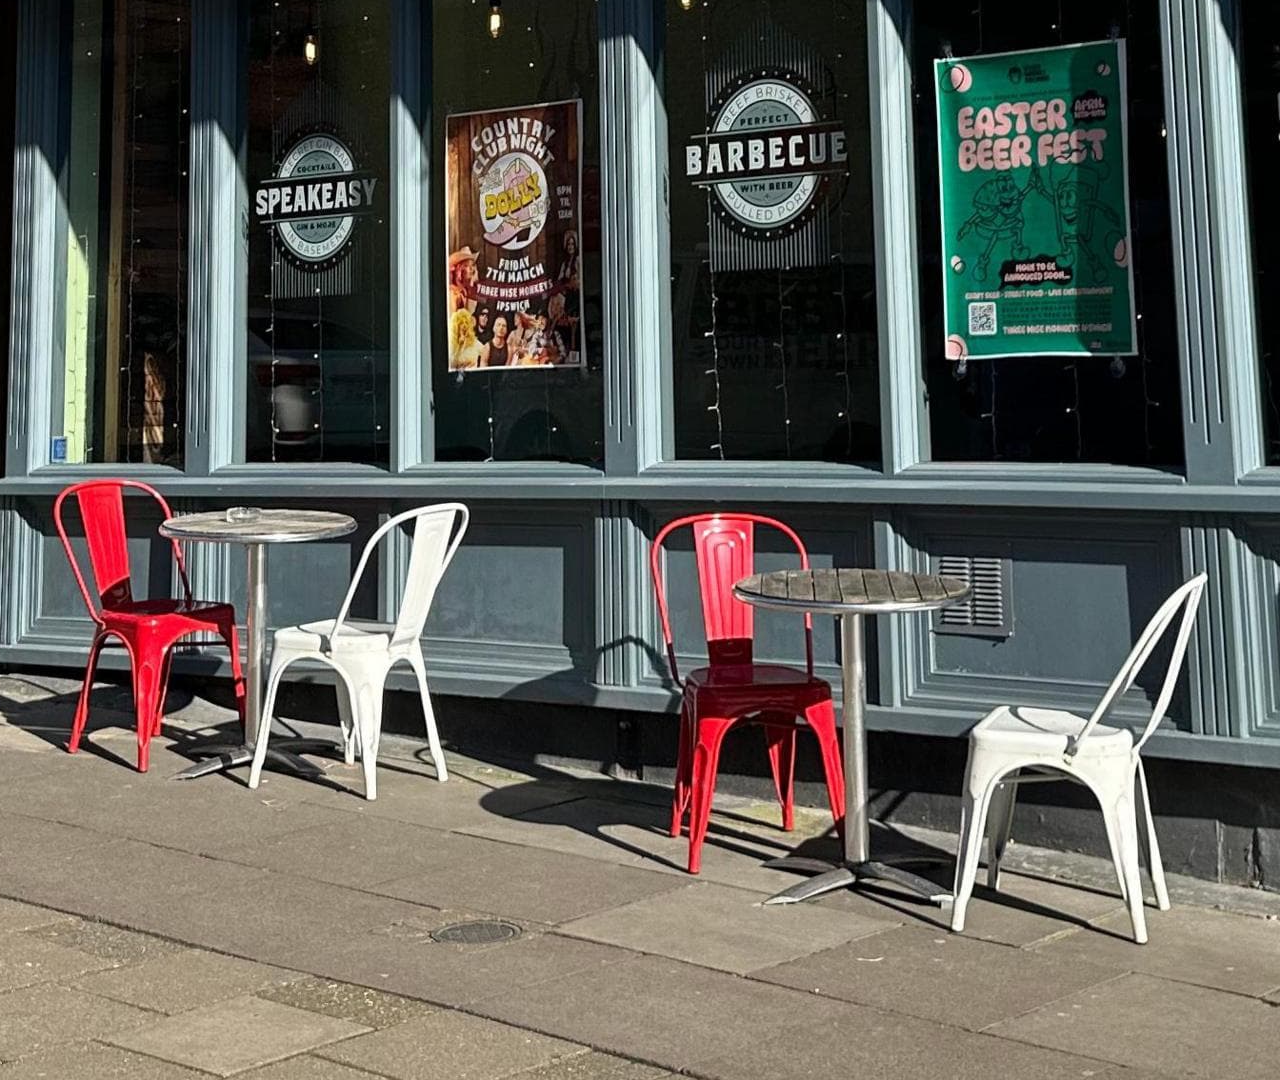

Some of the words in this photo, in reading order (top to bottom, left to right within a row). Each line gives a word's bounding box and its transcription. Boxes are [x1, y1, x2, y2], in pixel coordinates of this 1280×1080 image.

[722, 94, 752, 126] BEEF
[755, 86, 809, 116] BRISKET
[740, 113, 789, 127] PERFECT
[957, 98, 1068, 140] EASTER
[1074, 97, 1106, 111] APRIL
[471, 116, 557, 152] COUNTRY
[958, 134, 1033, 172] BEER
[1036, 127, 1108, 167] FEST
[297, 163, 336, 174] COCKTAILS
[472, 136, 508, 175] CLUB
[510, 133, 556, 167] NIGHT
[685, 130, 849, 176] BARBECUE
[255, 177, 378, 216] SPEAKEASY
[484, 170, 542, 221] DOLLY
[726, 191, 773, 221] PULLED
[777, 186, 810, 217] PORK
[740, 182, 766, 193] WITH
[769, 181, 794, 190] BEER
[297, 226, 347, 255] BASEMENT
[486, 266, 506, 282] 7TH
[507, 262, 545, 283] MARCH
[498, 255, 530, 271] FRIDAY
[477, 283, 499, 298] THREE
[499, 287, 518, 298] WISE
[518, 278, 554, 297] MONKEYS
[496, 299, 531, 313] IPSWICH
